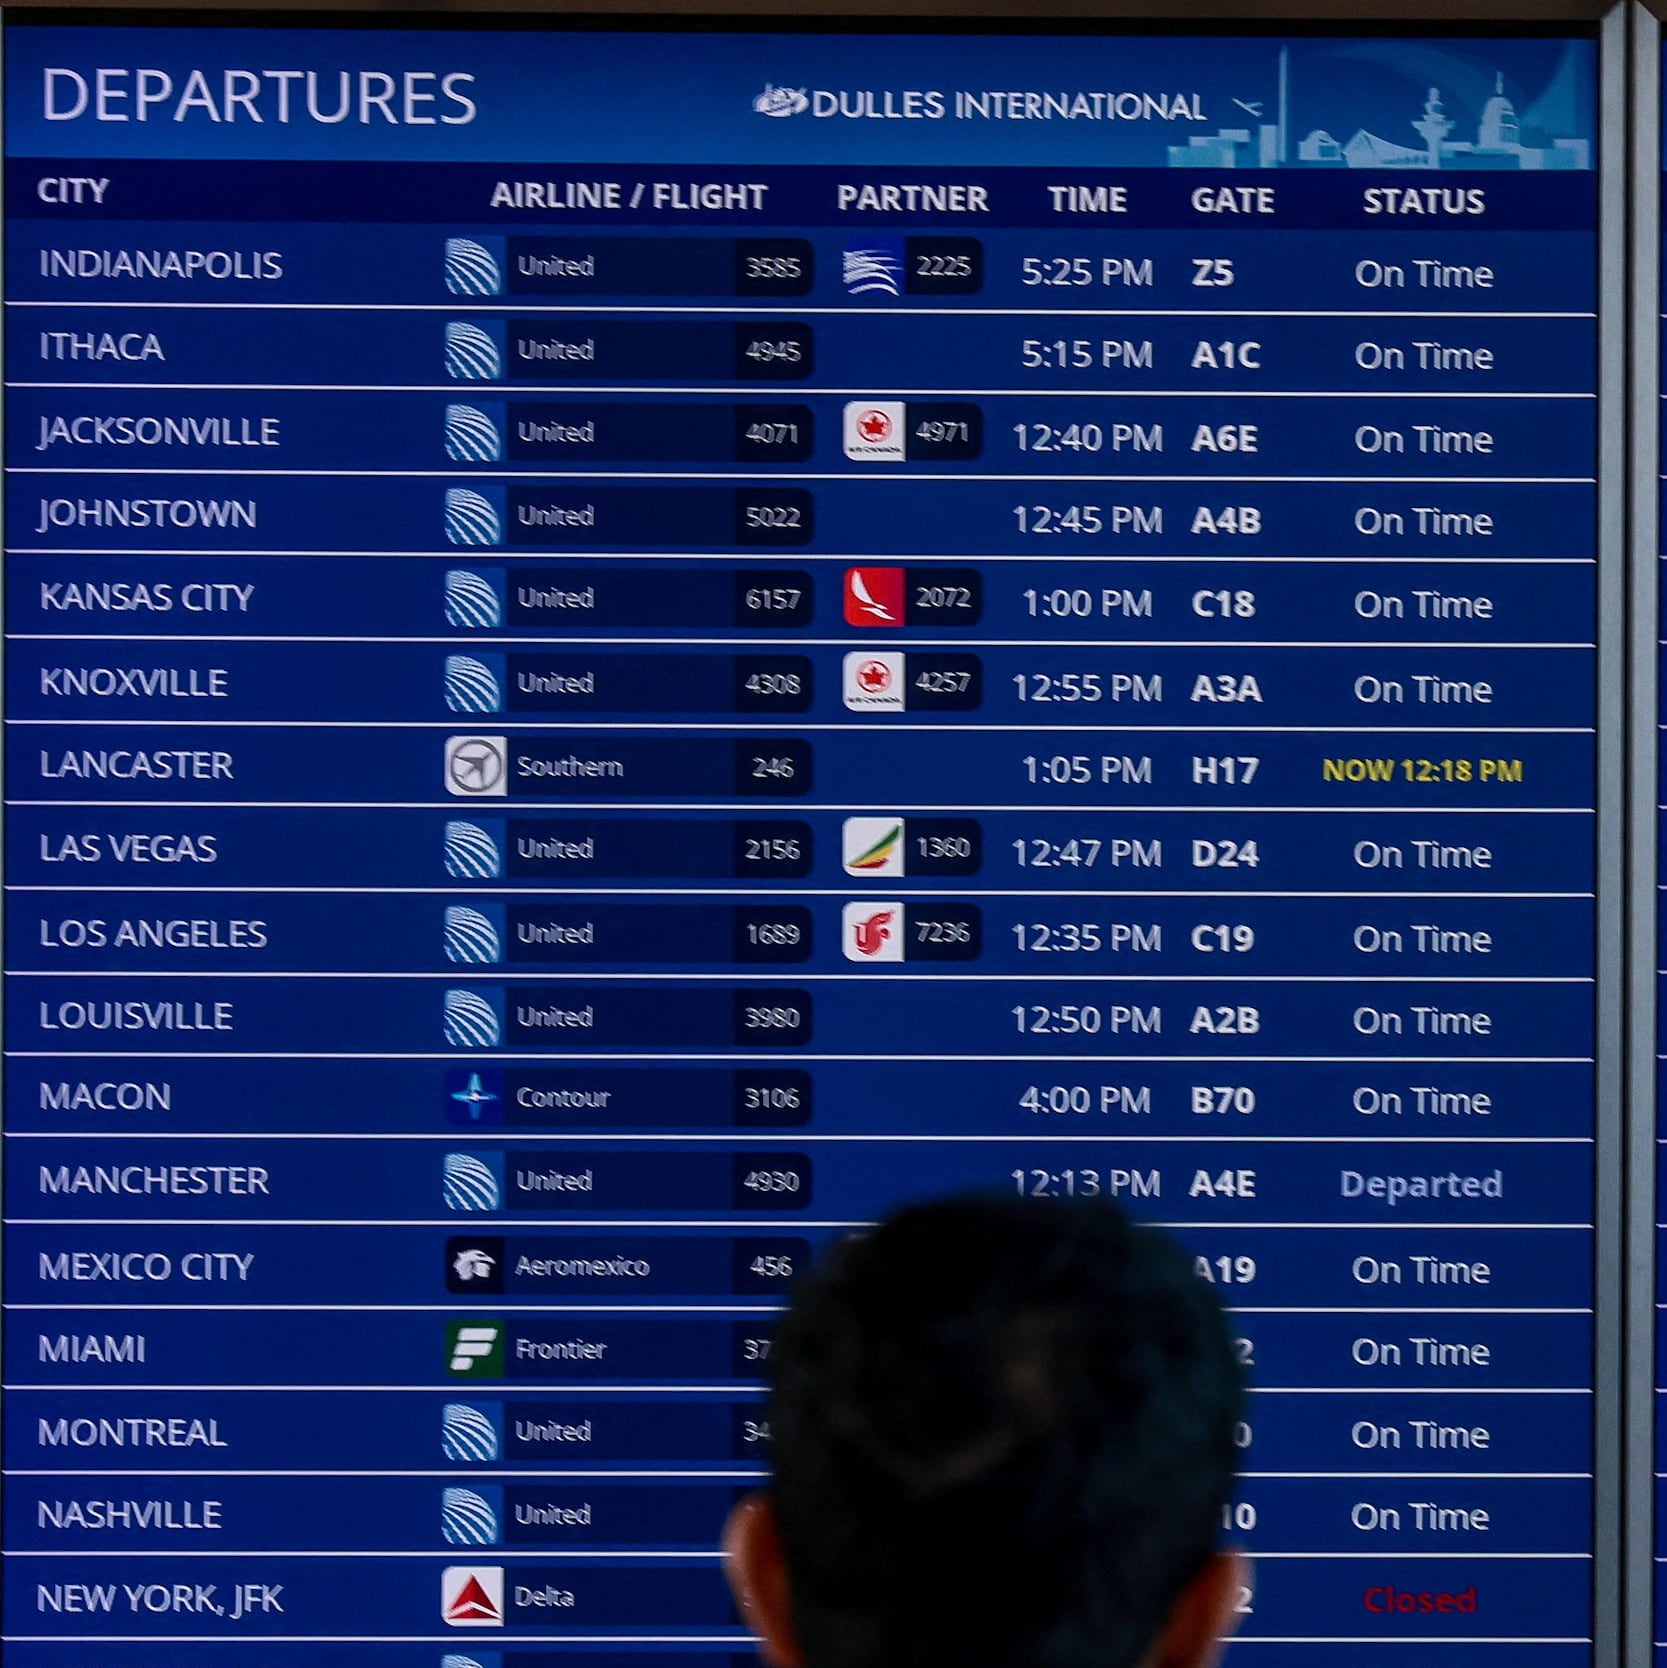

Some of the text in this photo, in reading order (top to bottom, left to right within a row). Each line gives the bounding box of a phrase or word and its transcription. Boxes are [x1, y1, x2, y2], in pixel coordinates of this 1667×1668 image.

[44, 68, 476, 124] DEPARTURES
[814, 91, 1207, 120] DULLES INTERNATIONAL
[38, 177, 110, 203] CITY
[490, 182, 769, 210] AIRLINE / FLIGHT
[838, 185, 990, 211] PARTNER
[1047, 186, 1127, 212] TIME
[1191, 187, 1275, 213] GATE
[1363, 188, 1485, 214] STATUS
[41, 250, 282, 279] INDIANAPOLIS
[519, 255, 594, 276] United
[1022, 258, 1153, 286] 5:25 PM
[1192, 259, 1234, 286] Z5
[1356, 260, 1494, 288] On Time
[41, 750, 234, 779] LANCASTER
[518, 755, 623, 776] Southern
[1023, 756, 1152, 784] 1:05 PM
[1193, 757, 1259, 784] H17
[1323, 759, 1522, 782] NOW 12:18 PM
[40, 1166, 269, 1194] MANCHESTER
[517, 1169, 592, 1191] United
[1012, 1169, 1160, 1197] 12:13 PM
[1189, 1170, 1256, 1197] A4E
[1341, 1170, 1502, 1206] Departed
[38, 1584, 284, 1619] NEW YORK, JFK
[515, 1585, 574, 1607] Delta
[1364, 1589, 1477, 1613] Closed
